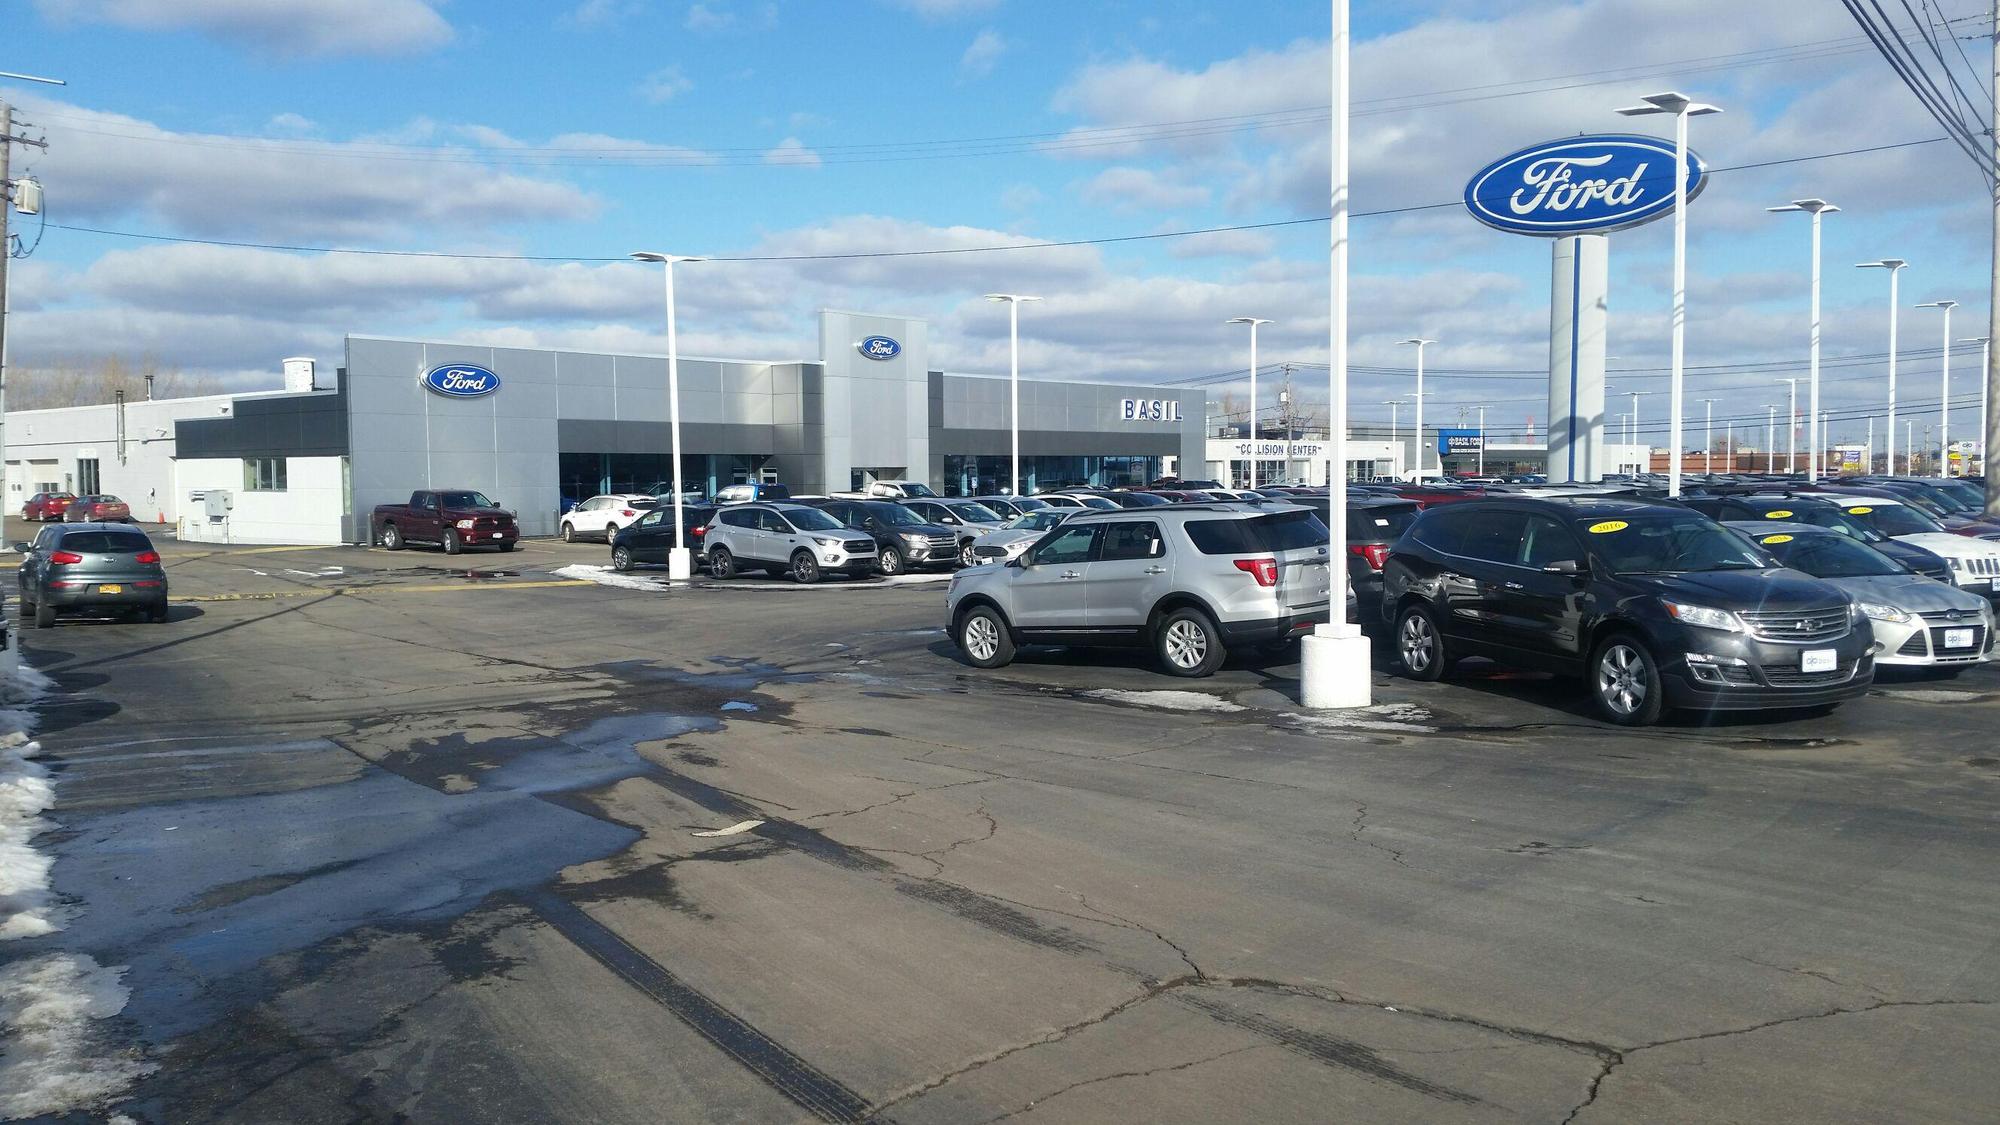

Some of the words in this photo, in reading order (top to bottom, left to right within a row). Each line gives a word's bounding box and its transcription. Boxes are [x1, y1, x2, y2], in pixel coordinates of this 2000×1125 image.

[1509, 153, 1649, 215] Ford
[870, 340, 894, 355] Ford
[442, 369, 487, 390] Ford
[1121, 399, 1183, 421] BASIL
[1240, 443, 1284, 454] COLISION
[1598, 522, 1621, 532] 2016
